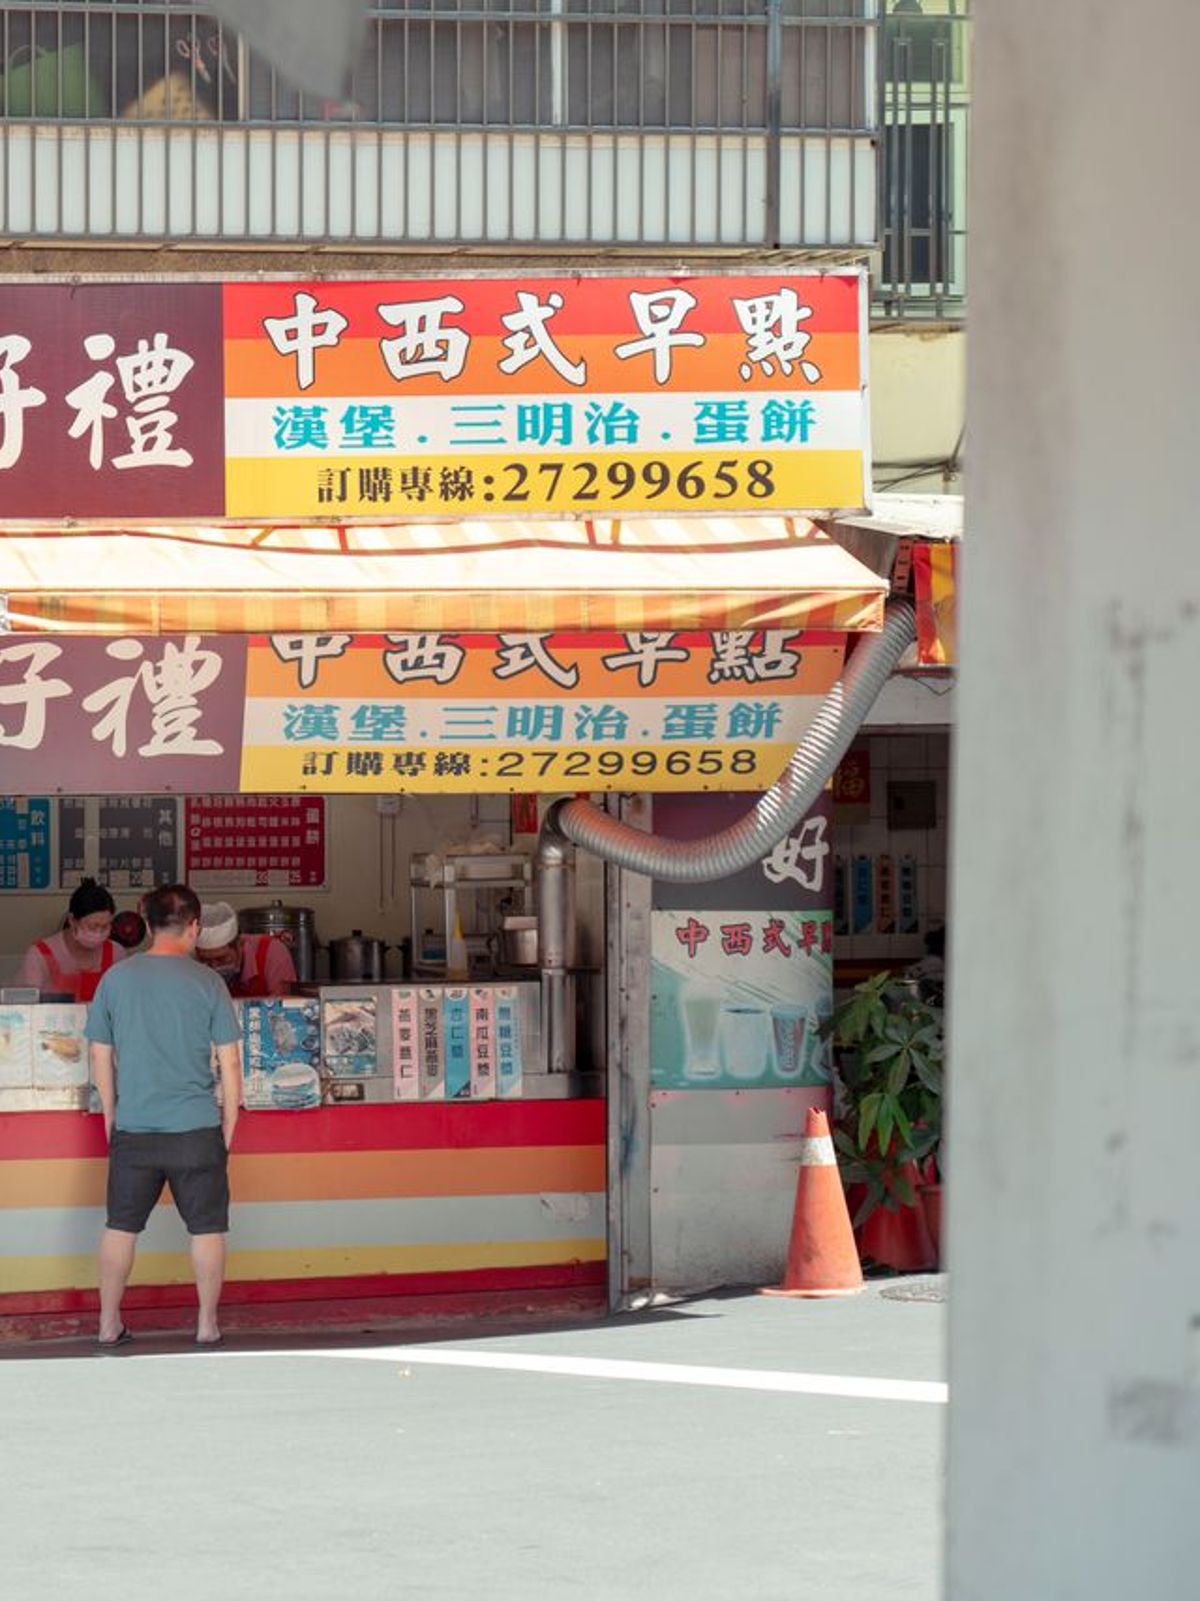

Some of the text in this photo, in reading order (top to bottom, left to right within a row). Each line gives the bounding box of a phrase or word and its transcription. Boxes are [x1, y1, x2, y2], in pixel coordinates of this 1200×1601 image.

[263, 288, 823, 390] 中西式早點
[269, 630, 802, 690] 中西式早點
[762, 816, 830, 892] 好
